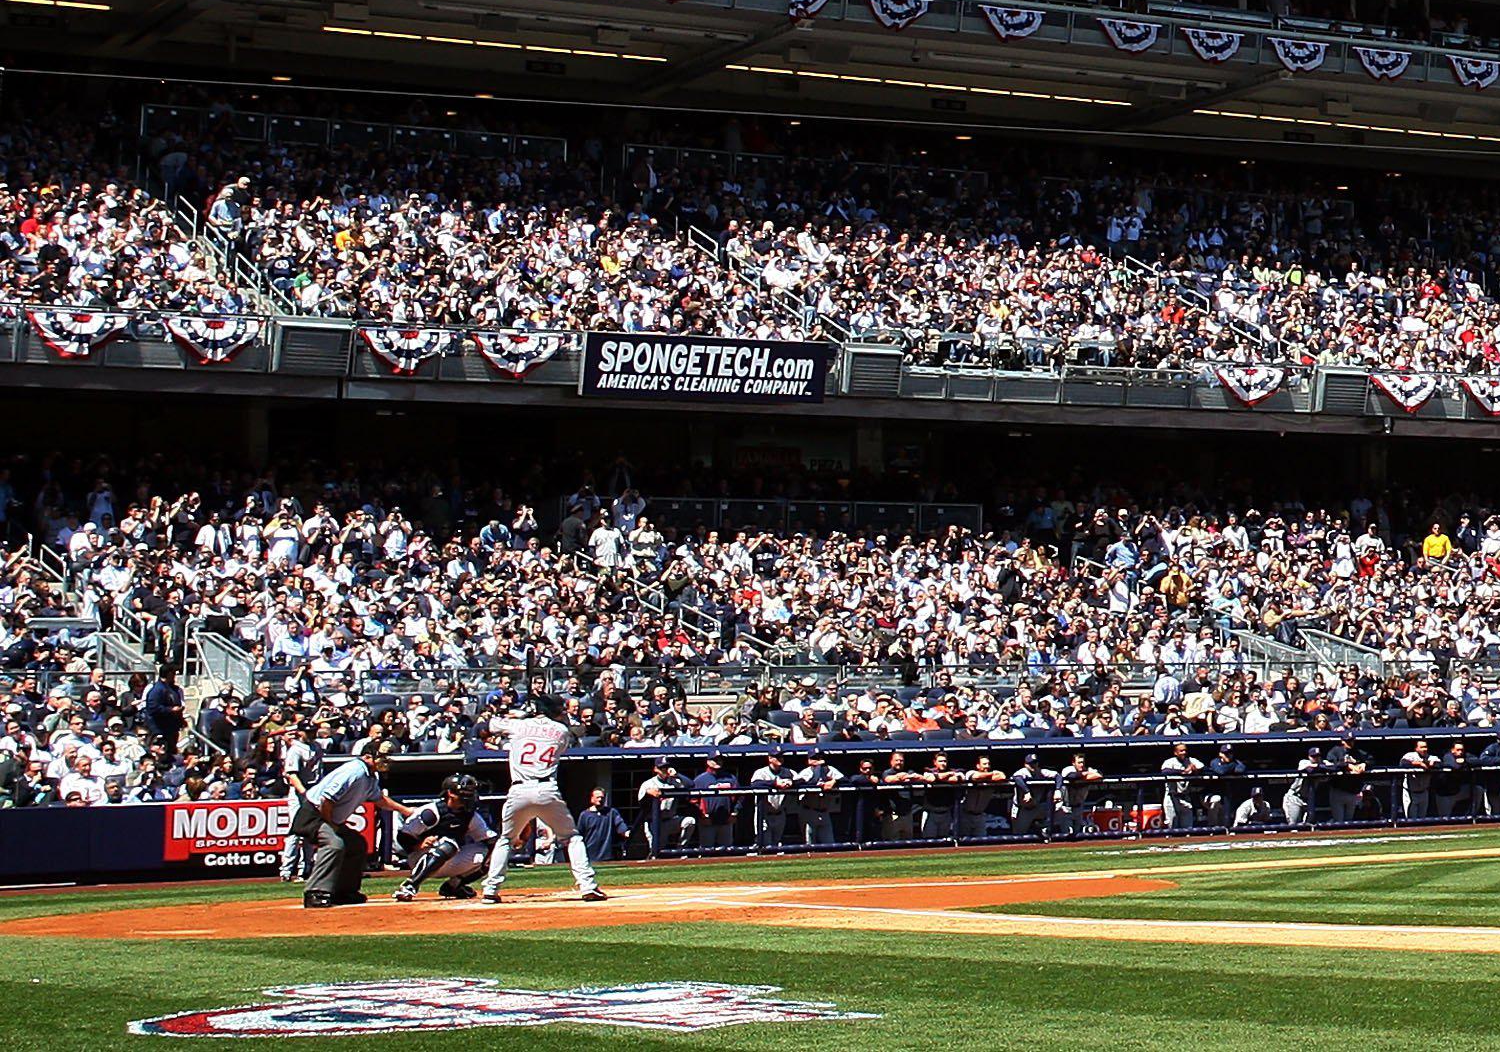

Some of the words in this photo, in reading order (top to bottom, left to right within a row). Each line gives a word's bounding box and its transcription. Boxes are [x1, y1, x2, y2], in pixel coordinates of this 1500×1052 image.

[598, 340, 814, 380] SPONGETECH.com
[597, 374, 672, 391] AMERICA'S
[674, 378, 741, 393] CLEANING
[520, 742, 558, 768] 24
[195, 837, 279, 849] SPORTING
